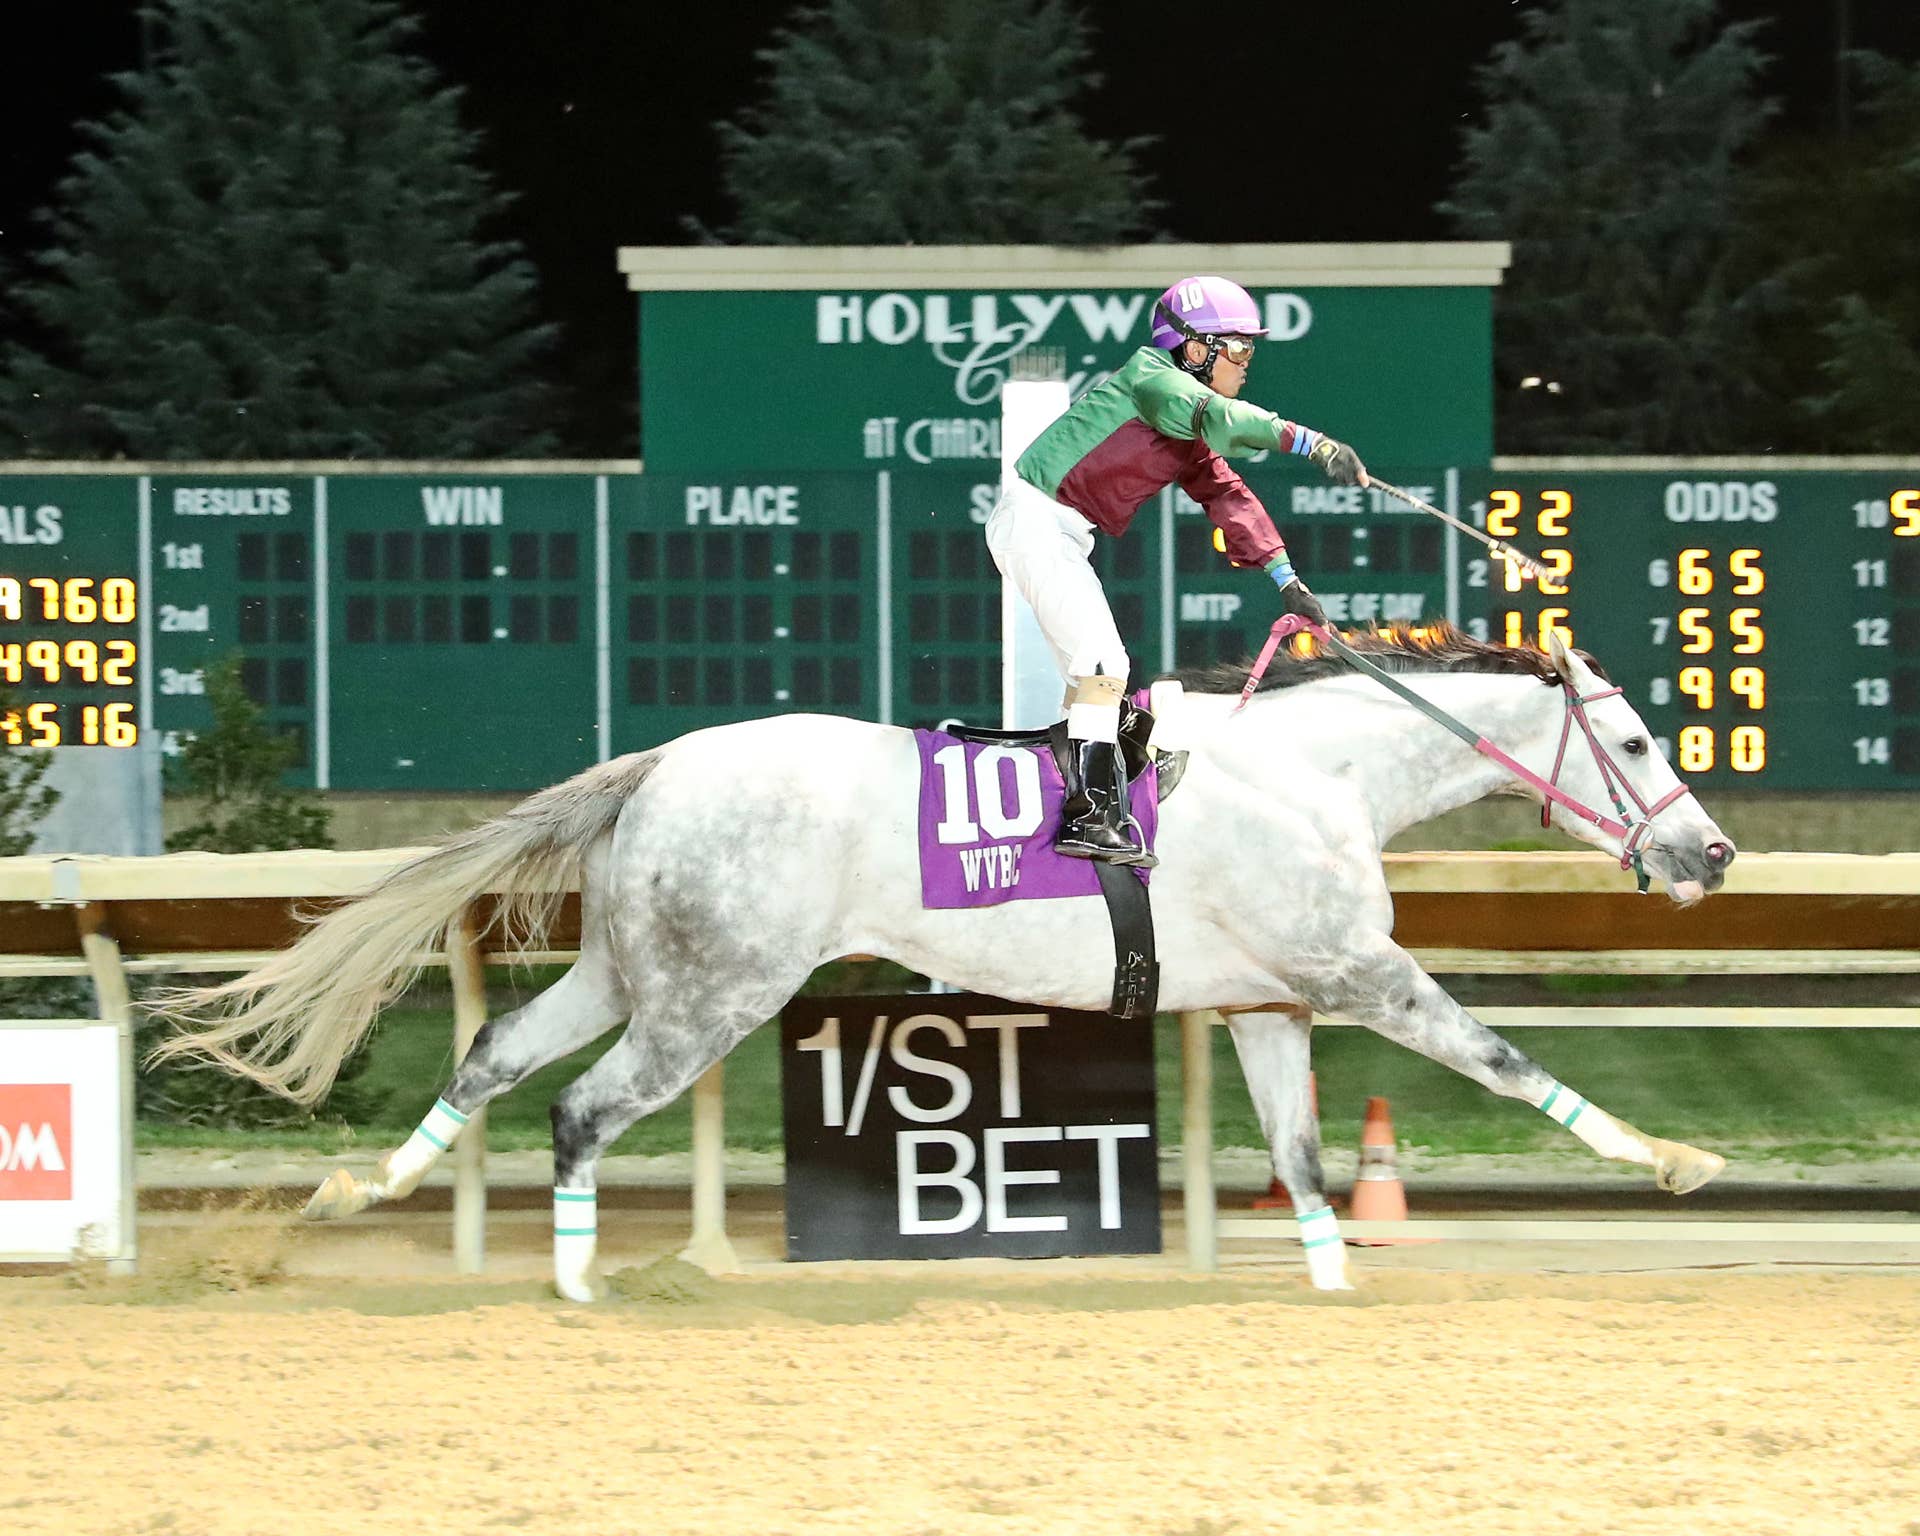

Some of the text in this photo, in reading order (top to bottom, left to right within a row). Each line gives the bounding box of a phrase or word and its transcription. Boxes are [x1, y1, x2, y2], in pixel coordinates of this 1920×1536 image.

[1177, 283, 1205, 312] 10
[816, 292, 1312, 345] HOLLYWD
[864, 417, 1001, 464] AT CHARL
[173, 487, 291, 516] RESULTS
[421, 486, 503, 526] WIN
[685, 486, 800, 526] PLACE
[1291, 485, 1364, 514] RACE
[1664, 481, 1779, 523] ODDS
[1469, 500, 1486, 529] 1
[1852, 500, 1889, 529] 10
[162, 542, 204, 570] 1st
[1467, 559, 1488, 588] 2
[1648, 559, 1670, 587] 6
[1852, 560, 1887, 587] 11
[1650, 616, 1670, 645] 7
[1852, 618, 1890, 646] 12
[1650, 677, 1671, 706] 8
[1852, 678, 1890, 706] 13
[1853, 736, 1890, 765] 14
[933, 744, 1044, 844] 10
[959, 843, 1023, 892] WVBC
[796, 1013, 1050, 1136] 1/ST
[896, 1123, 1151, 1235] BET
